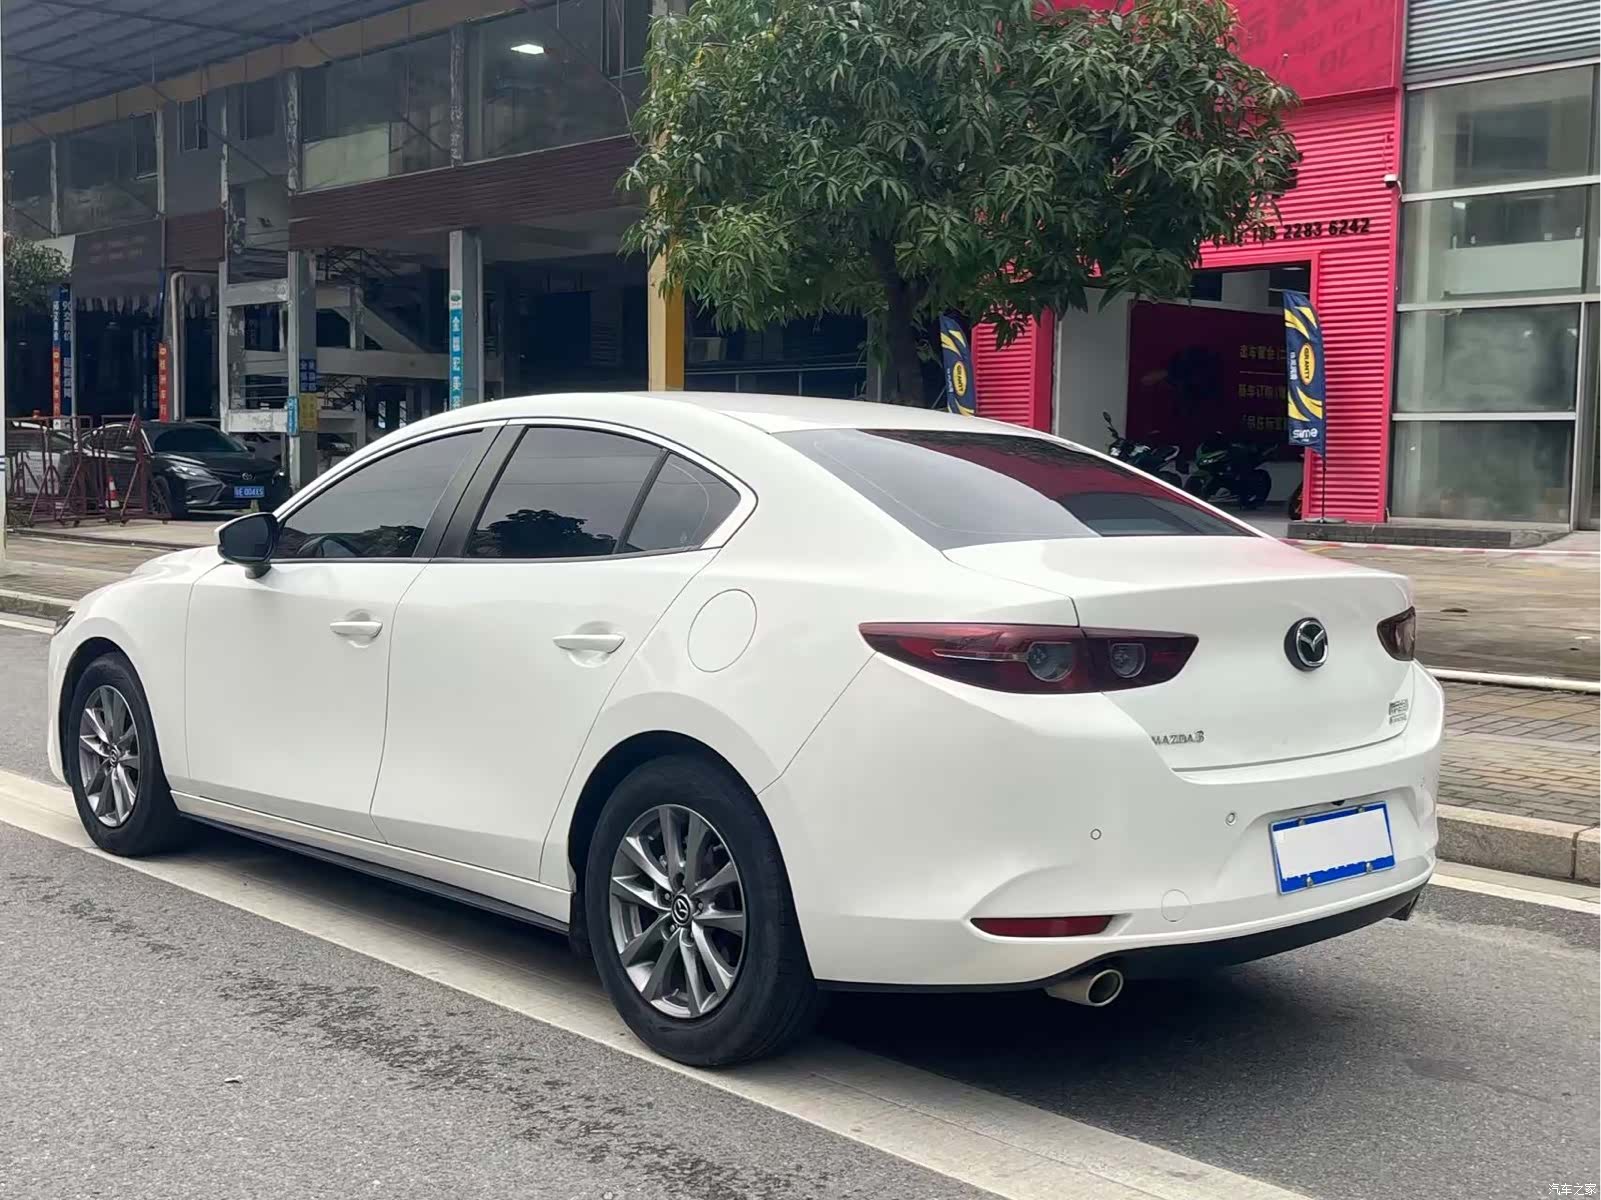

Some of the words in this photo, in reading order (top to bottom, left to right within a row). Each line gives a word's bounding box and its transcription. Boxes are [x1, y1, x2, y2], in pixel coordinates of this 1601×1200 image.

[1283, 222, 1322, 240] 2283
[1328, 217, 1370, 235] 6242
[1151, 730, 1204, 745] MAZDA3
